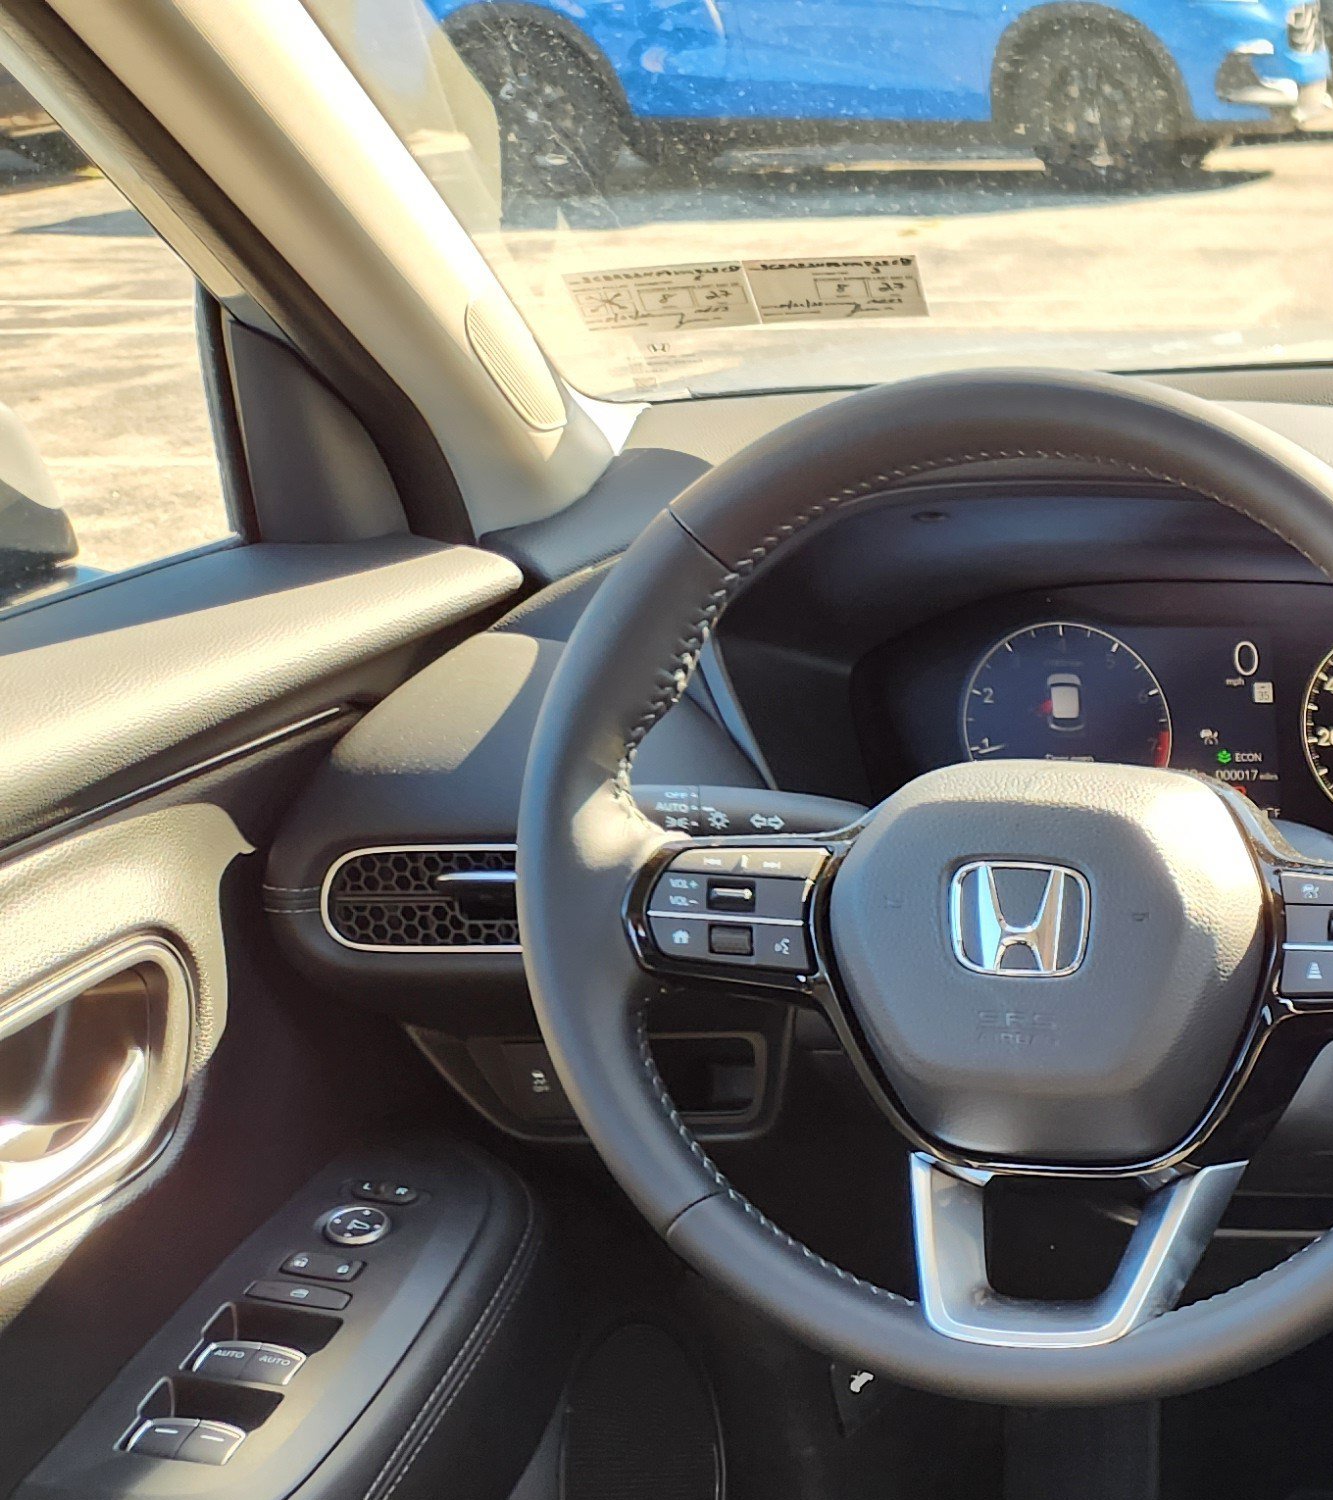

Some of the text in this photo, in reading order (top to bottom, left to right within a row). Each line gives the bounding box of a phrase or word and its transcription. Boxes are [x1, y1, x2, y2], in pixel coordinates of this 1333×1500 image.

[1235, 640, 1259, 677] 0
[983, 687, 995, 704] 2
[1234, 751, 1262, 763] ECON
[1215, 768, 1259, 782] 000017
[655, 801, 689, 813] AUTO
[213, 1349, 245, 1359] AUTO
[258, 1355, 291, 1366] AUTO
